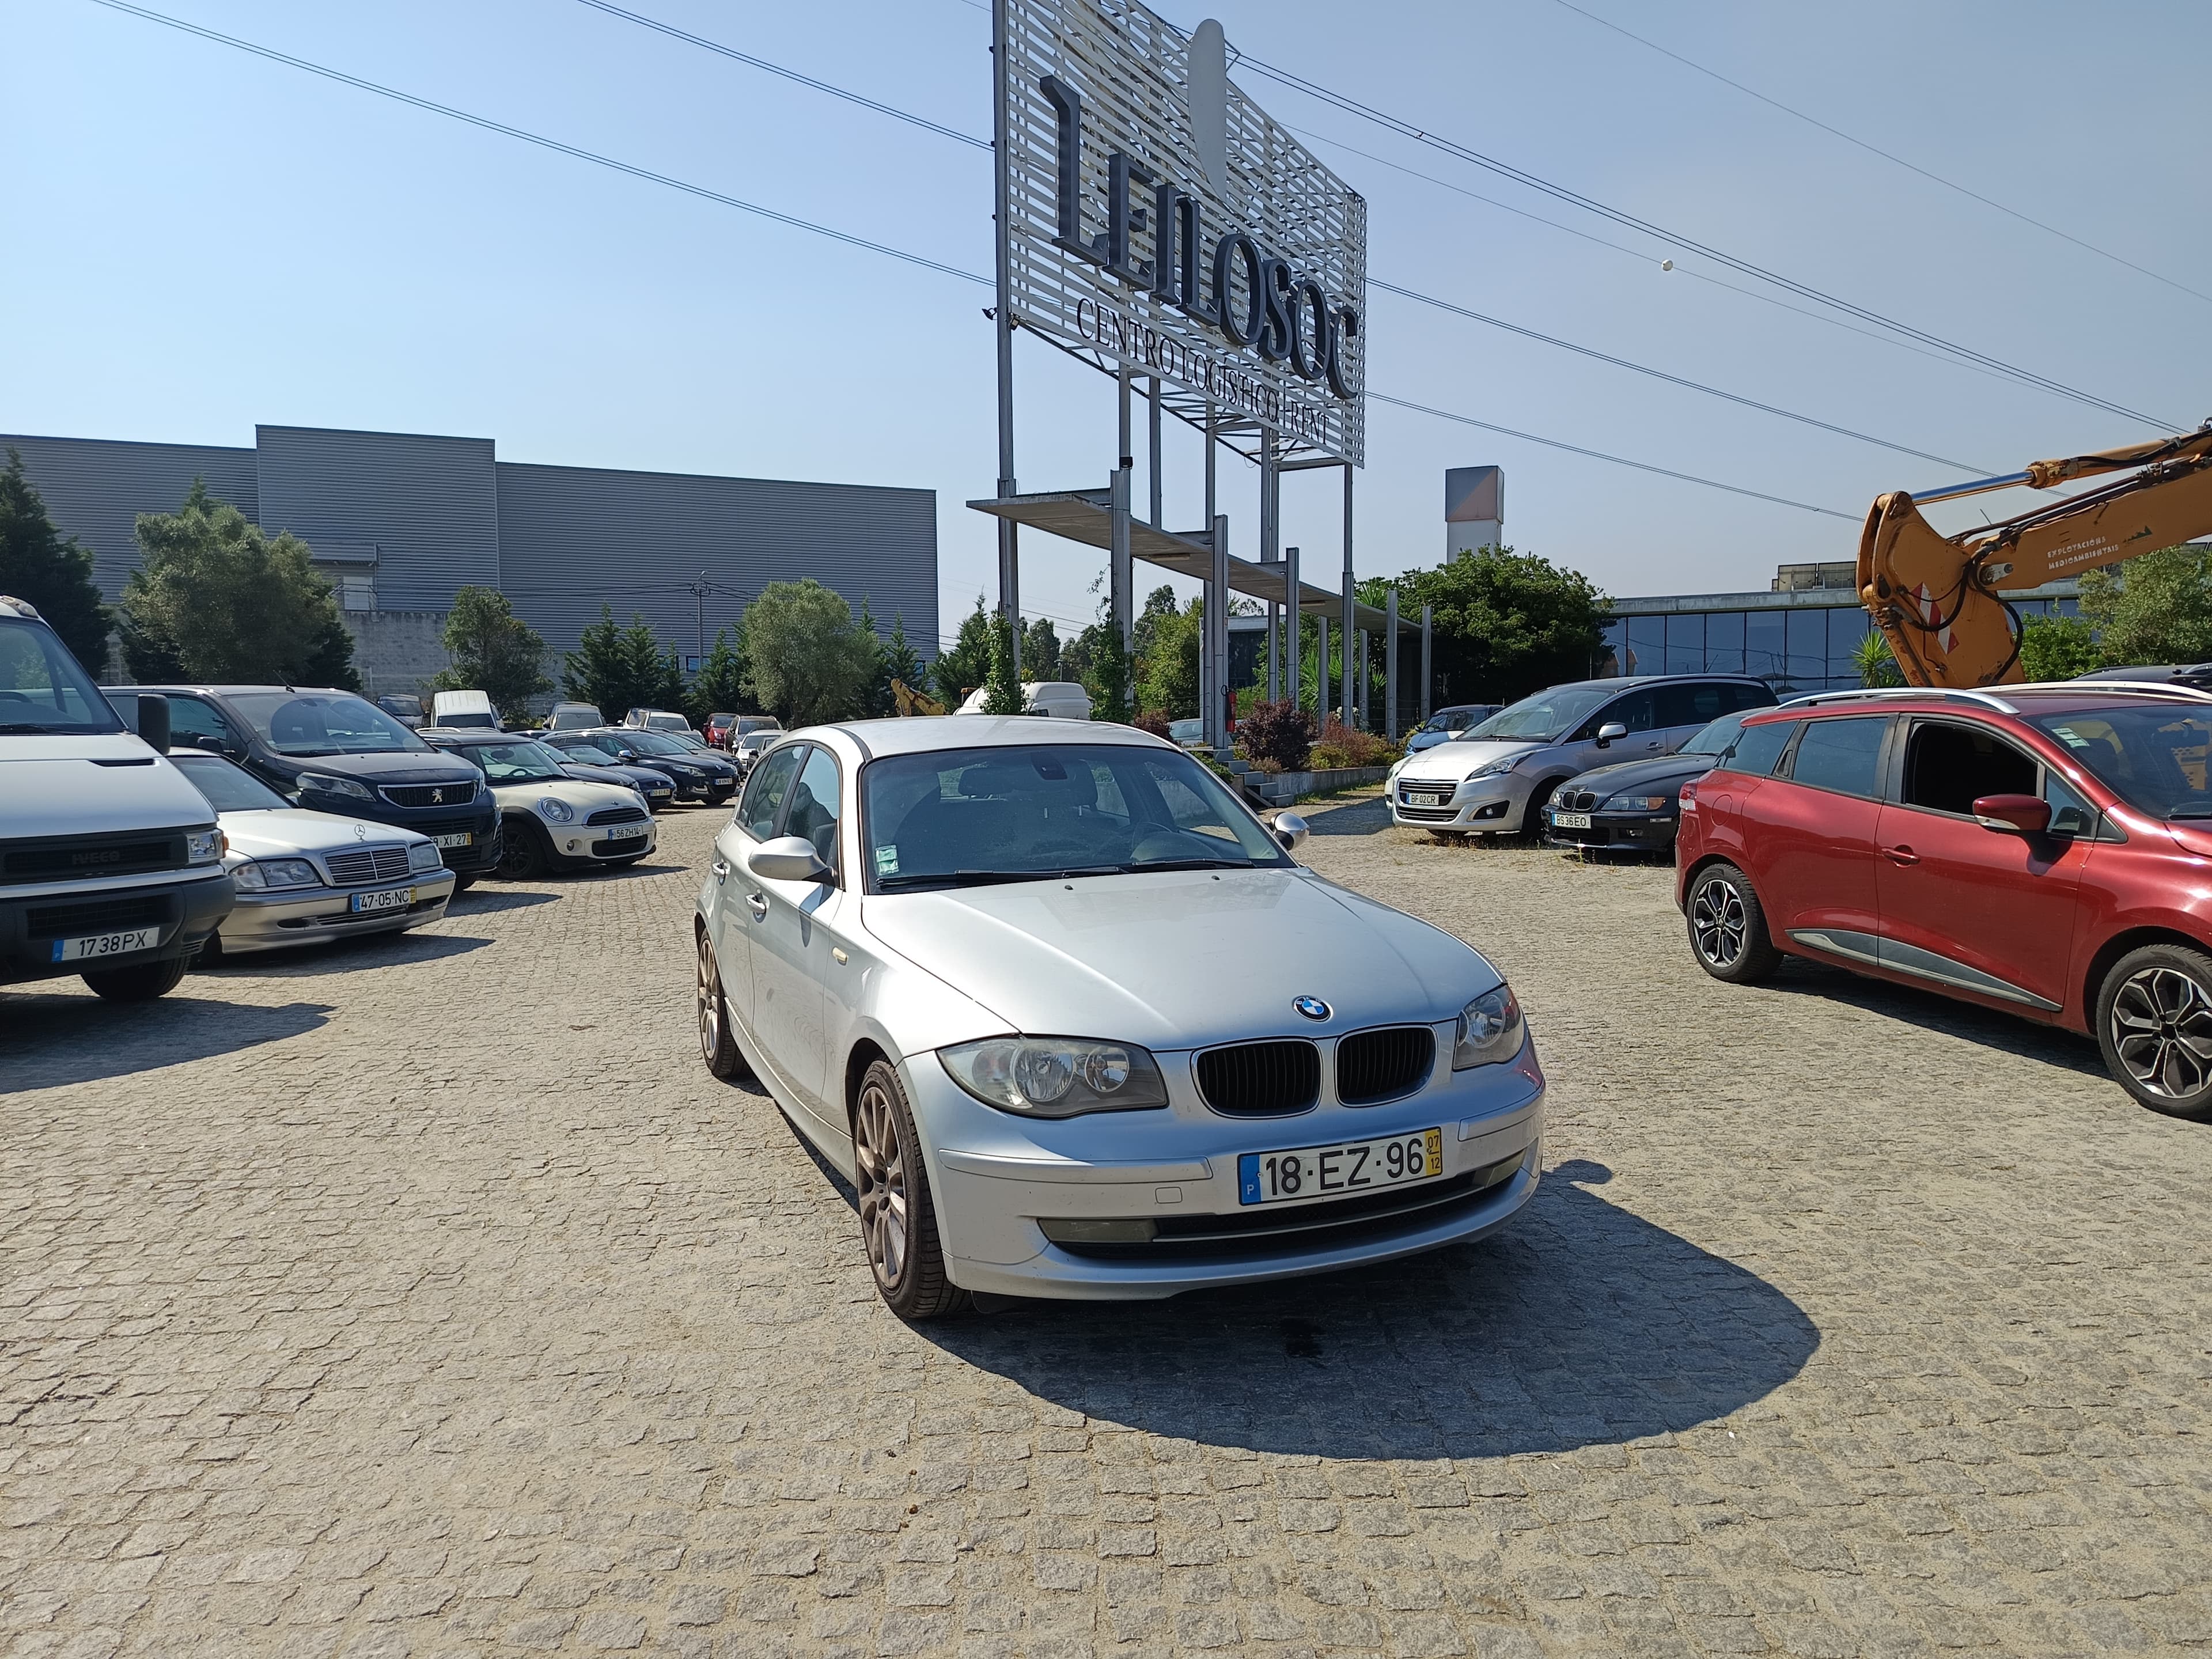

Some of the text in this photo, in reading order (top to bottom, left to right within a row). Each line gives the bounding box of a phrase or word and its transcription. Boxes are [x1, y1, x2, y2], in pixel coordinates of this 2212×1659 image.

[1040, 75, 1358, 399] LEILOSOC
[1077, 298, 1330, 445] CENTRO LOGÍSTICO RENT
[1427, 1135, 1440, 1149] 07
[1430, 1157, 1441, 1171] 12
[1247, 1184, 1255, 1195] P
